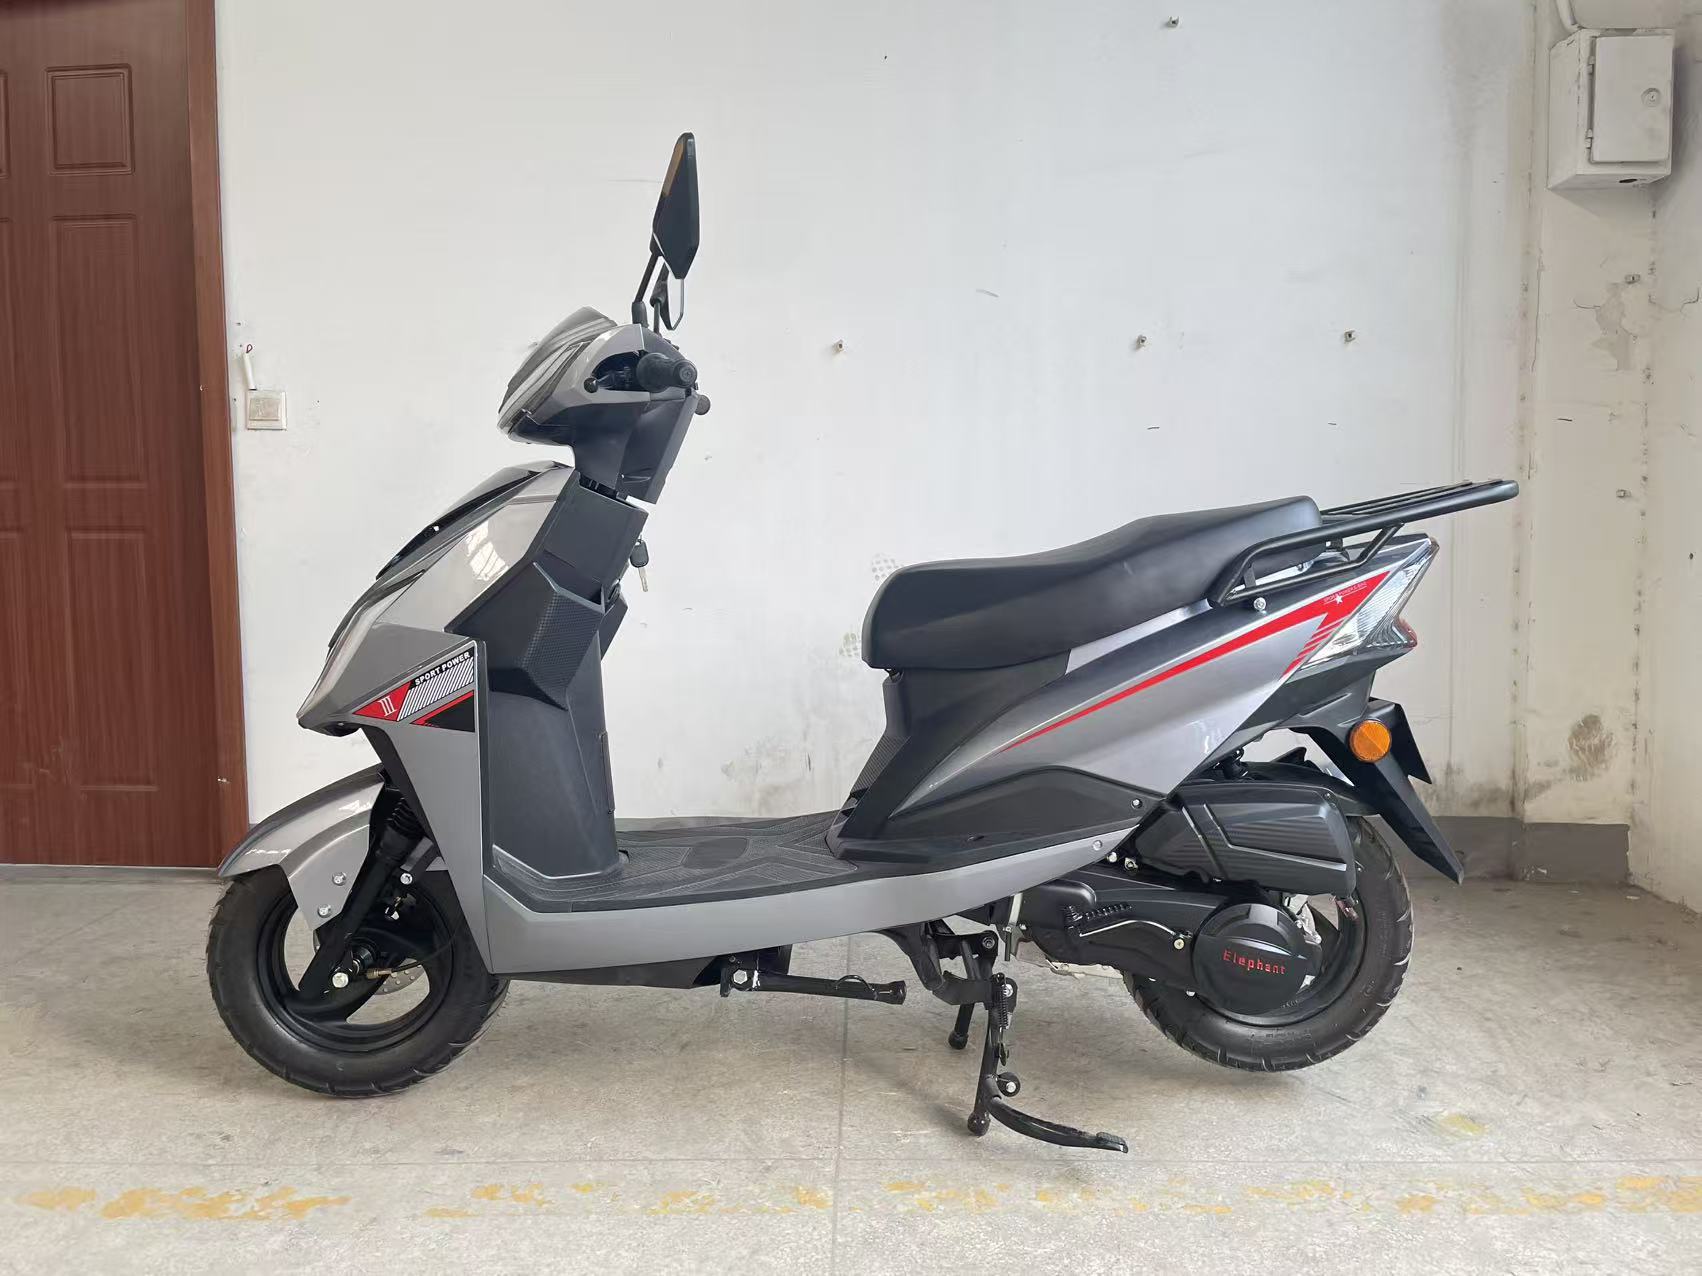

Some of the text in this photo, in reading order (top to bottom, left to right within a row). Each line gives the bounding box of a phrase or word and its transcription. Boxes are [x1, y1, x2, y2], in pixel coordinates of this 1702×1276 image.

[414, 651, 471, 686] SPORT POWER
[1222, 949, 1286, 975] Elephant
